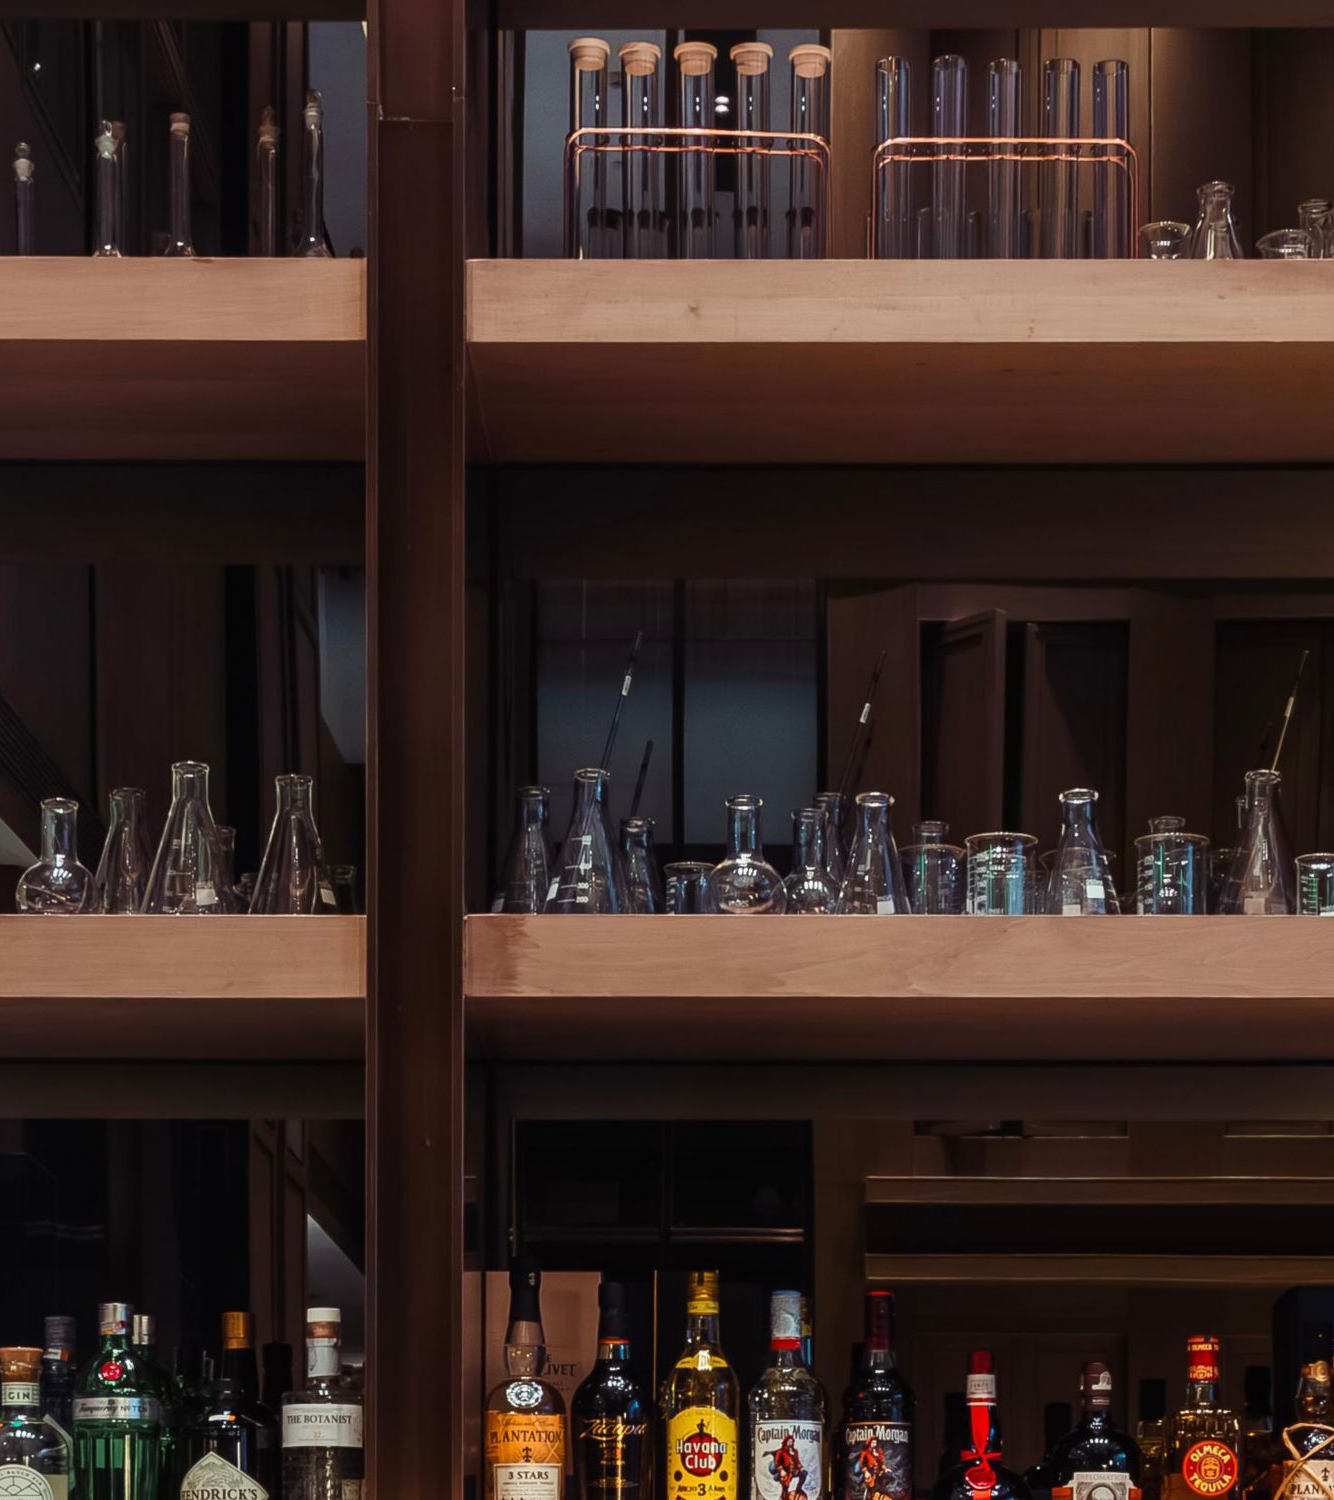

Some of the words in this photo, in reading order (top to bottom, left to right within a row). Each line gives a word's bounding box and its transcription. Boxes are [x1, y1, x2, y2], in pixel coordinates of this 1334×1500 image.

[8, 1392, 30, 1400] GIN
[287, 1415, 303, 1424] THE
[304, 1414, 353, 1425] BOTANIST
[490, 1430, 563, 1444] PLANTATION
[757, 1425, 790, 1444] Captain
[790, 1424, 821, 1444] Morgan
[846, 1426, 875, 1446] Captain
[875, 1425, 909, 1444] Morgan
[676, 1439, 727, 1455] Havana
[1189, 1444, 1231, 1464] OLMECA
[685, 1455, 717, 1470] Club
[508, 1472, 514, 1480] 3
[517, 1472, 549, 1480] STARS
[1189, 1474, 1233, 1492] TEQUILA
[697, 1483, 707, 1496] 3
